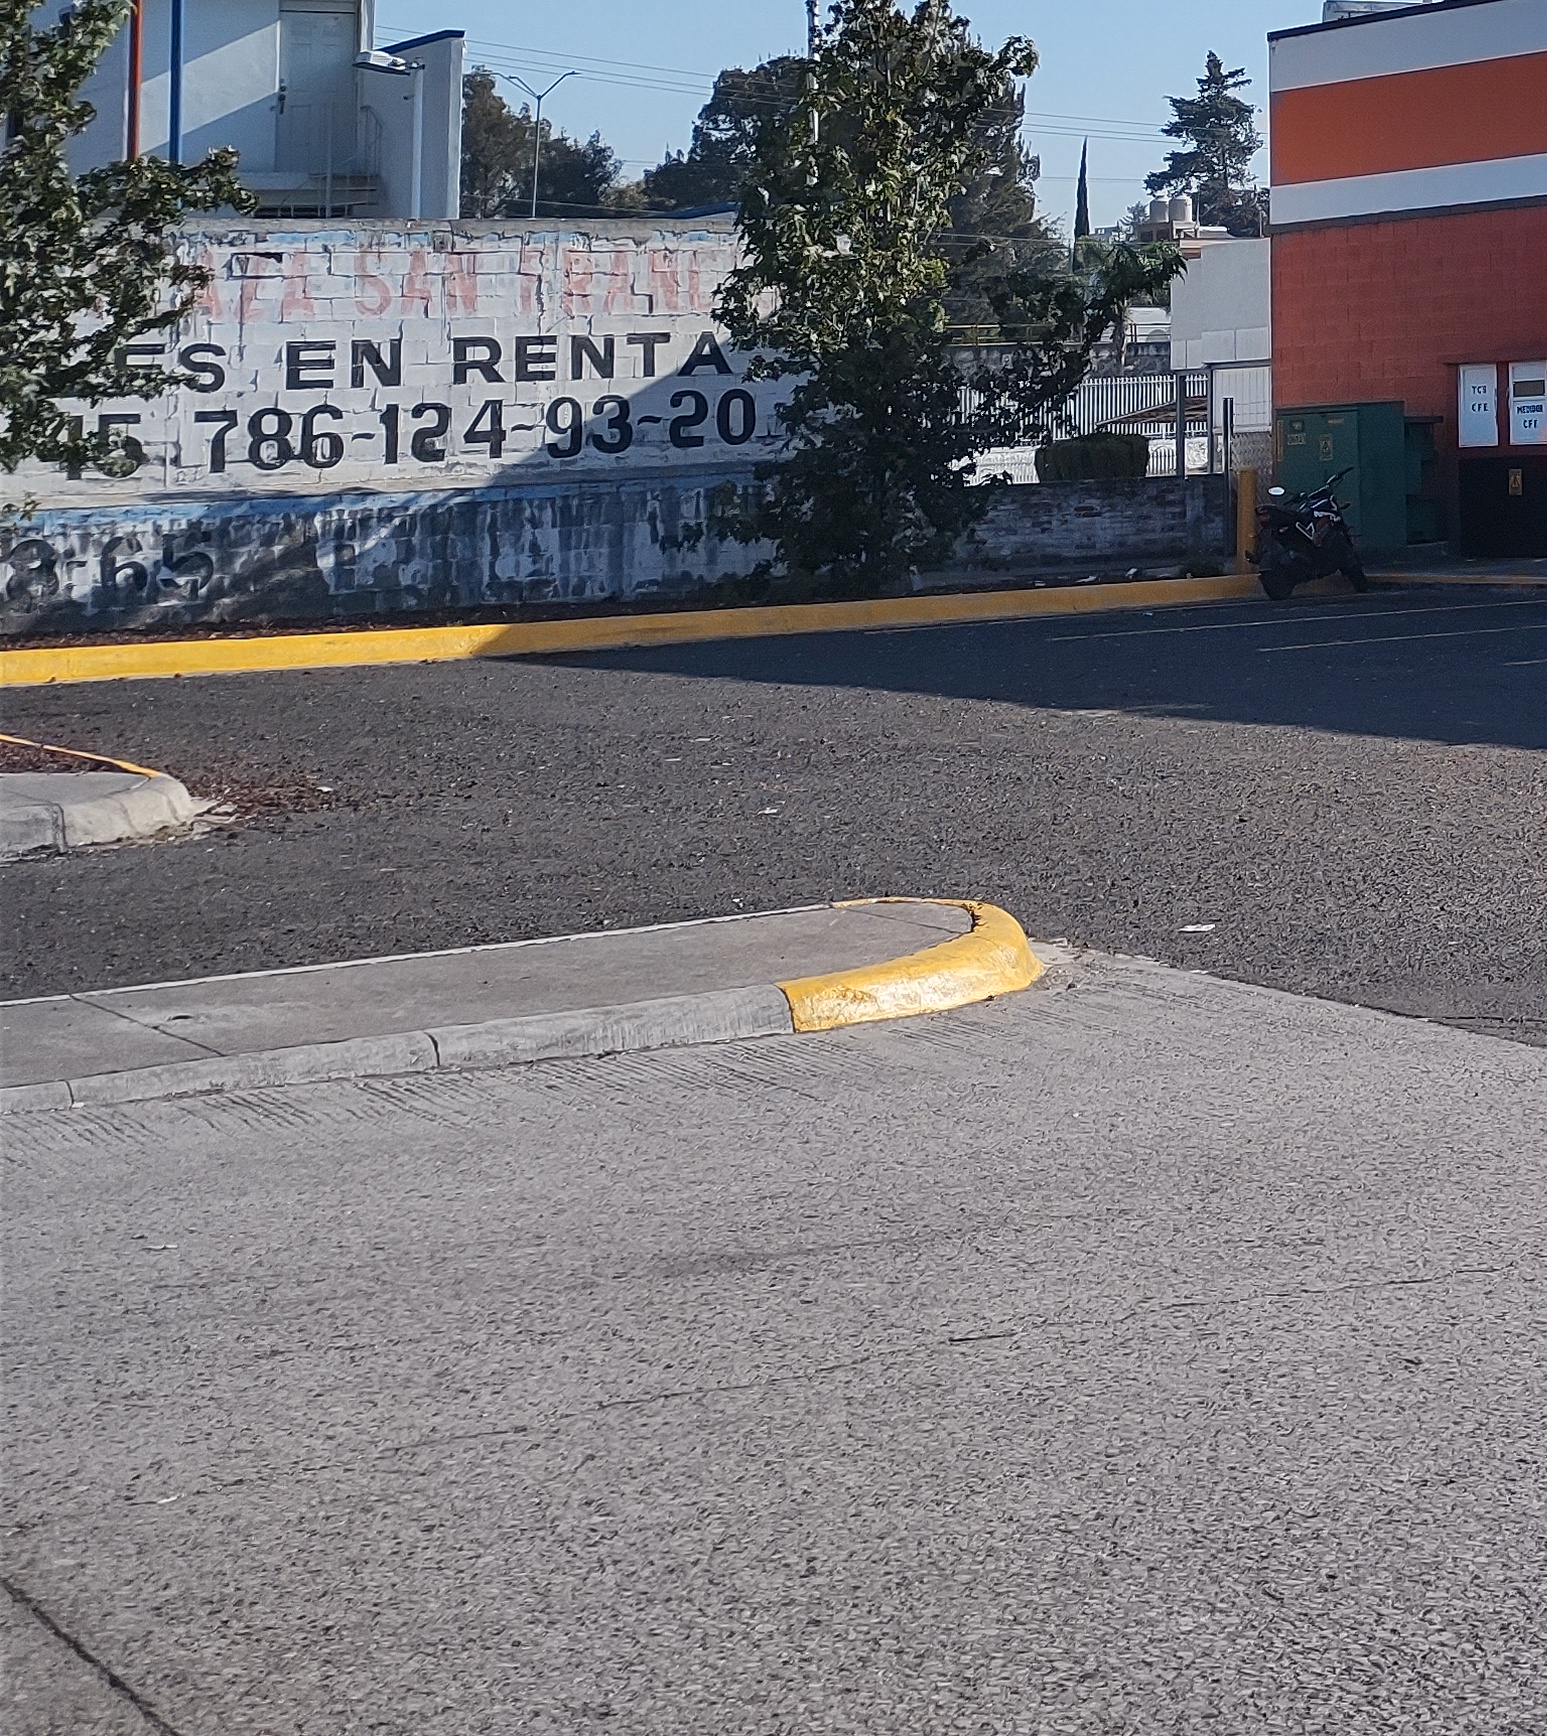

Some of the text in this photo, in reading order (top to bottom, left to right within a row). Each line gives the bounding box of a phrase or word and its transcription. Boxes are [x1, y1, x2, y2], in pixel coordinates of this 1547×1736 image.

[114, 330, 734, 394] ES EN RENTA
[193, 388, 757, 475] 786-124-93-20
